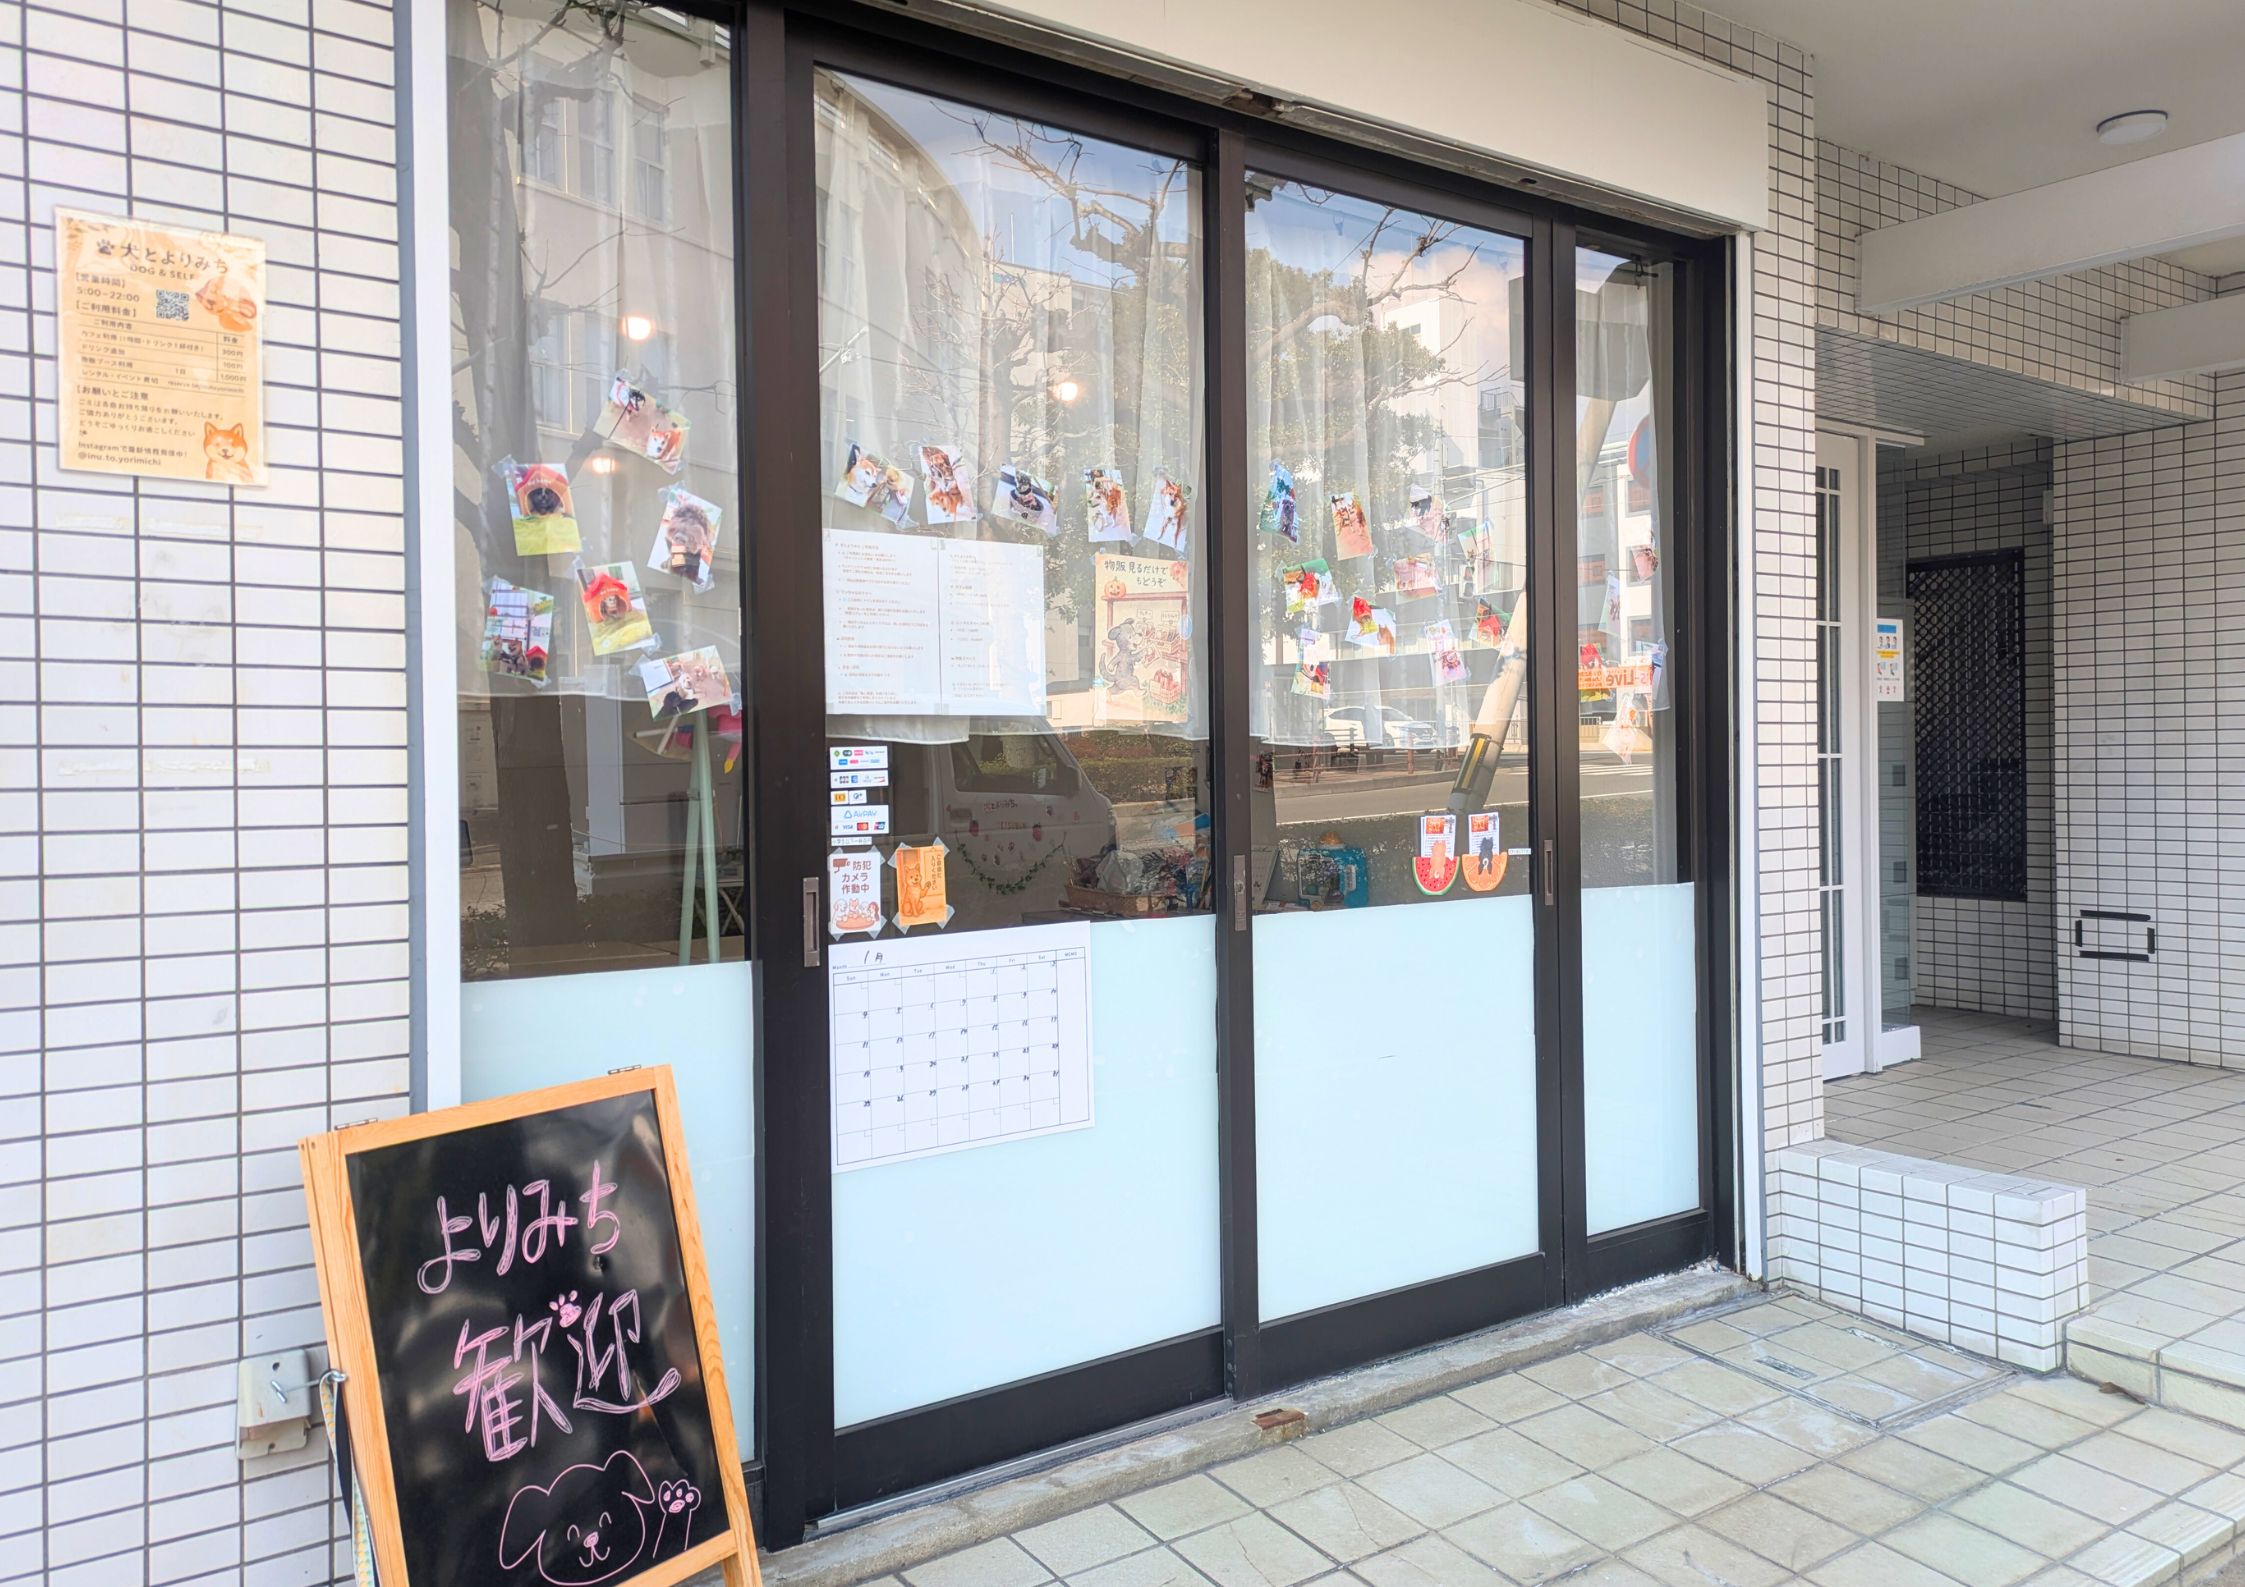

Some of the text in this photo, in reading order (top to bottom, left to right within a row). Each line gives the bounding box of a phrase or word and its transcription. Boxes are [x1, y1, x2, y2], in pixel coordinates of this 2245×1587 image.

[120, 242, 228, 274] 犬とよりみち
[130, 265, 195, 280] DOG & SELF
[1137, 577, 1167, 588] もどうぞ
[853, 861, 872, 871] 防犯
[842, 873, 868, 883] カメラ
[842, 884, 870, 895] 作動中
[417, 1160, 621, 1294] よりみち
[453, 1289, 681, 1462] 歓迎
